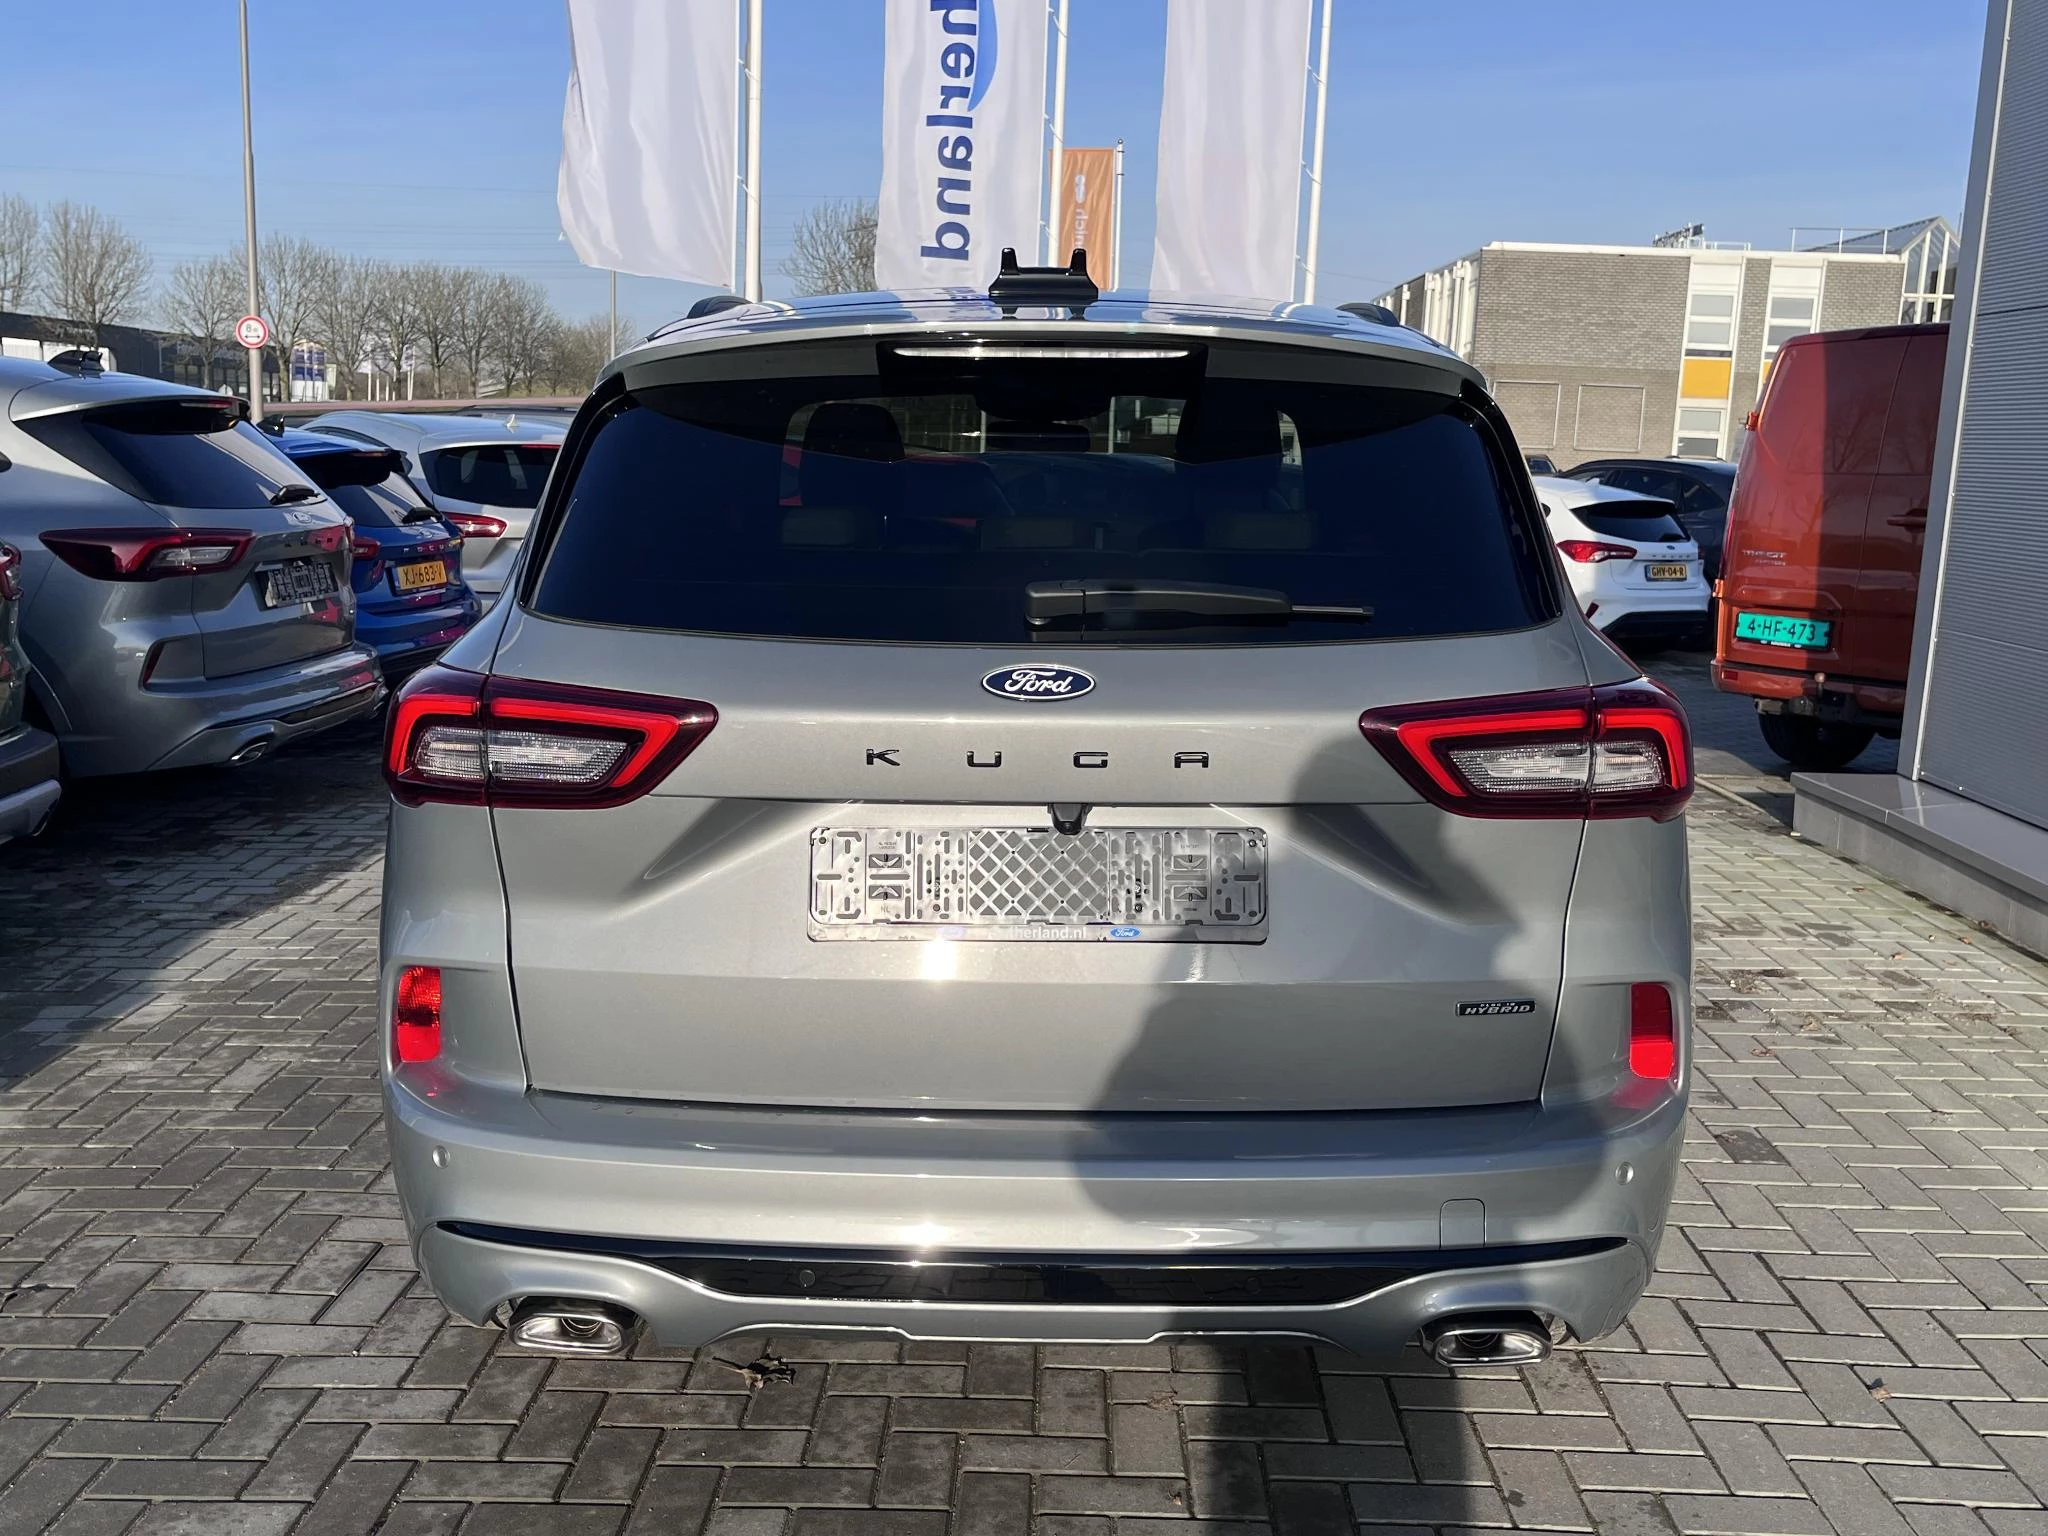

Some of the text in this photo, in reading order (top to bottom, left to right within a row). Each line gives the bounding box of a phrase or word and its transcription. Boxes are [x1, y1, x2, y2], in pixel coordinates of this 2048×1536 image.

[403, 563, 443, 585] XJ-683-V
[1747, 617, 1816, 641] 4-HF-473
[1004, 669, 1074, 693] Ford
[866, 748, 1209, 769] KUGA
[1464, 1004, 1531, 1015] HYBRID
